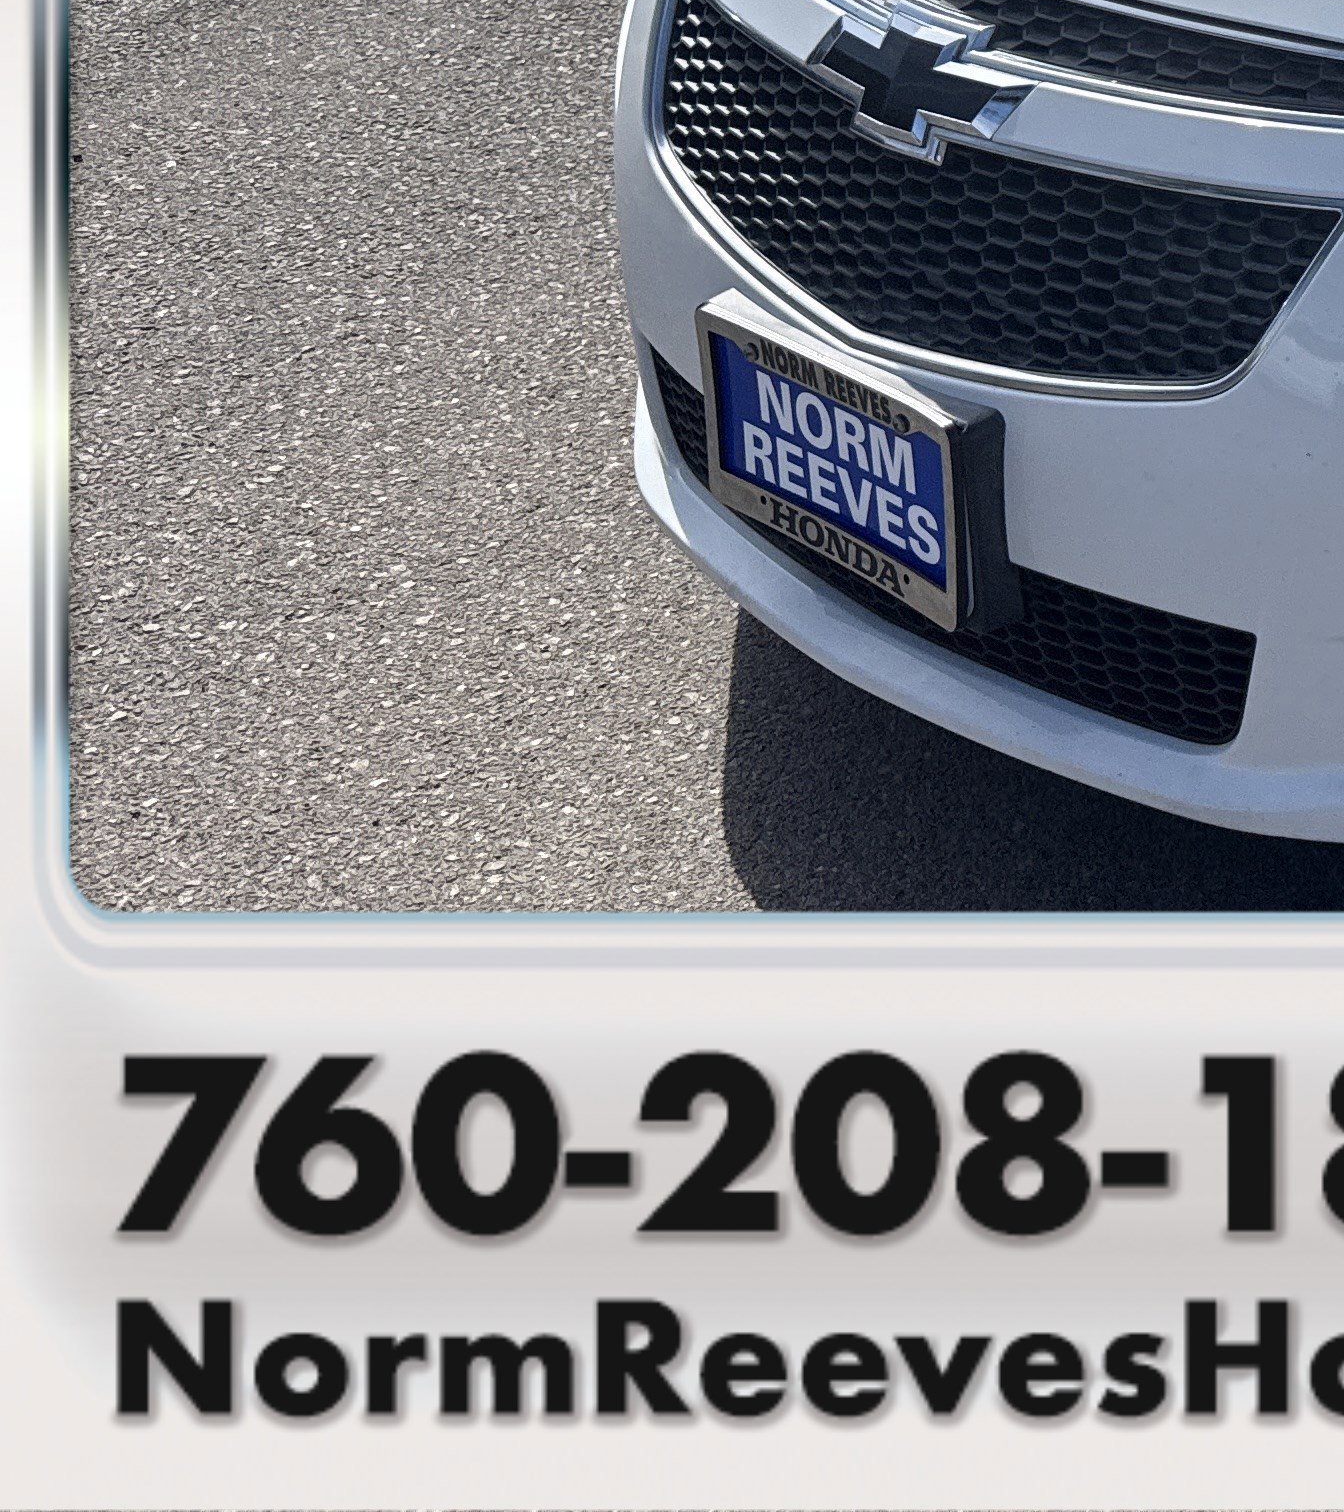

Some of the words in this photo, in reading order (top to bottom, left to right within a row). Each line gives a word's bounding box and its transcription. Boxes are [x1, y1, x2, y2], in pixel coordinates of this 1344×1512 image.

[755, 369, 918, 495] NORM
[759, 340, 820, 389] NORM
[823, 369, 892, 420] REEVES
[742, 420, 942, 566] REEVES
